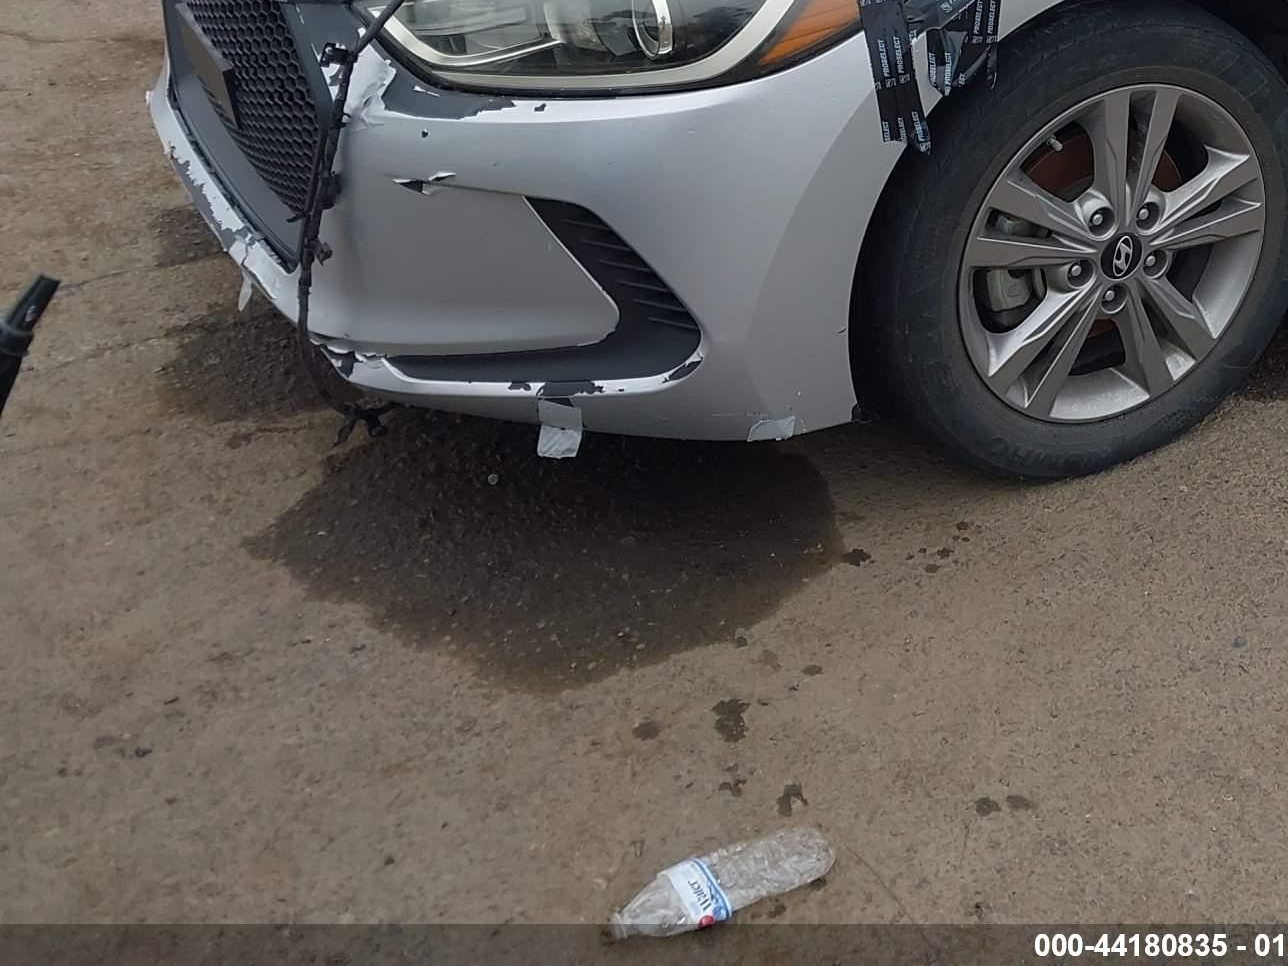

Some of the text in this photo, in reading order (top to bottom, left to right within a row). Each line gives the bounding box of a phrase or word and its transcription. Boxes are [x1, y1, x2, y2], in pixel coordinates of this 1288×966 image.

[973, 0, 983, 35] PROSELECT
[987, 0, 996, 34] PROSELECT
[877, 39, 890, 77] PROSELECT
[893, 36, 905, 74] PROSELECT
[687, 880, 712, 911] Water
